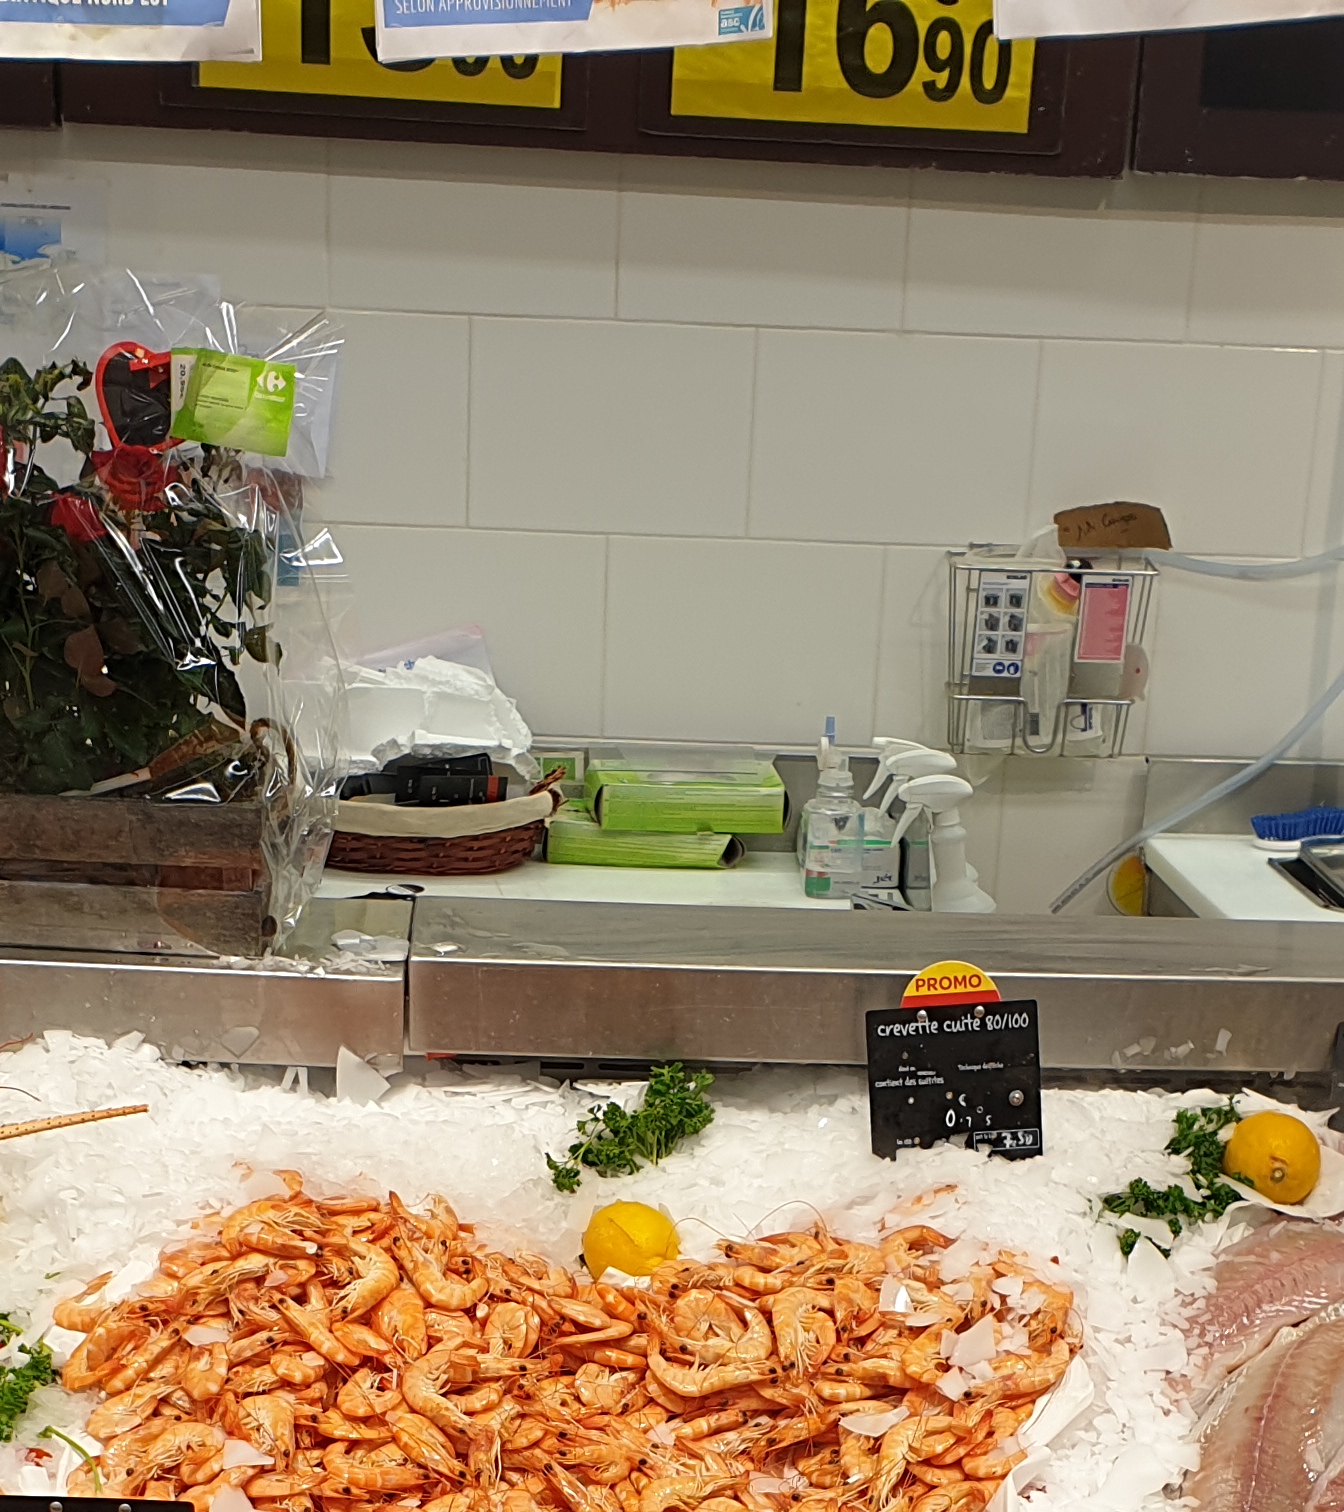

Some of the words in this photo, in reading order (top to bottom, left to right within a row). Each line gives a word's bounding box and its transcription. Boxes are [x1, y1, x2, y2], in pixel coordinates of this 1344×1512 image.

[922, 17, 1012, 105] 90
[915, 974, 983, 993] PROMO
[877, 1016, 939, 1037] crevette
[943, 1013, 981, 1033] cuite
[985, 1012, 1029, 1031] 80/100
